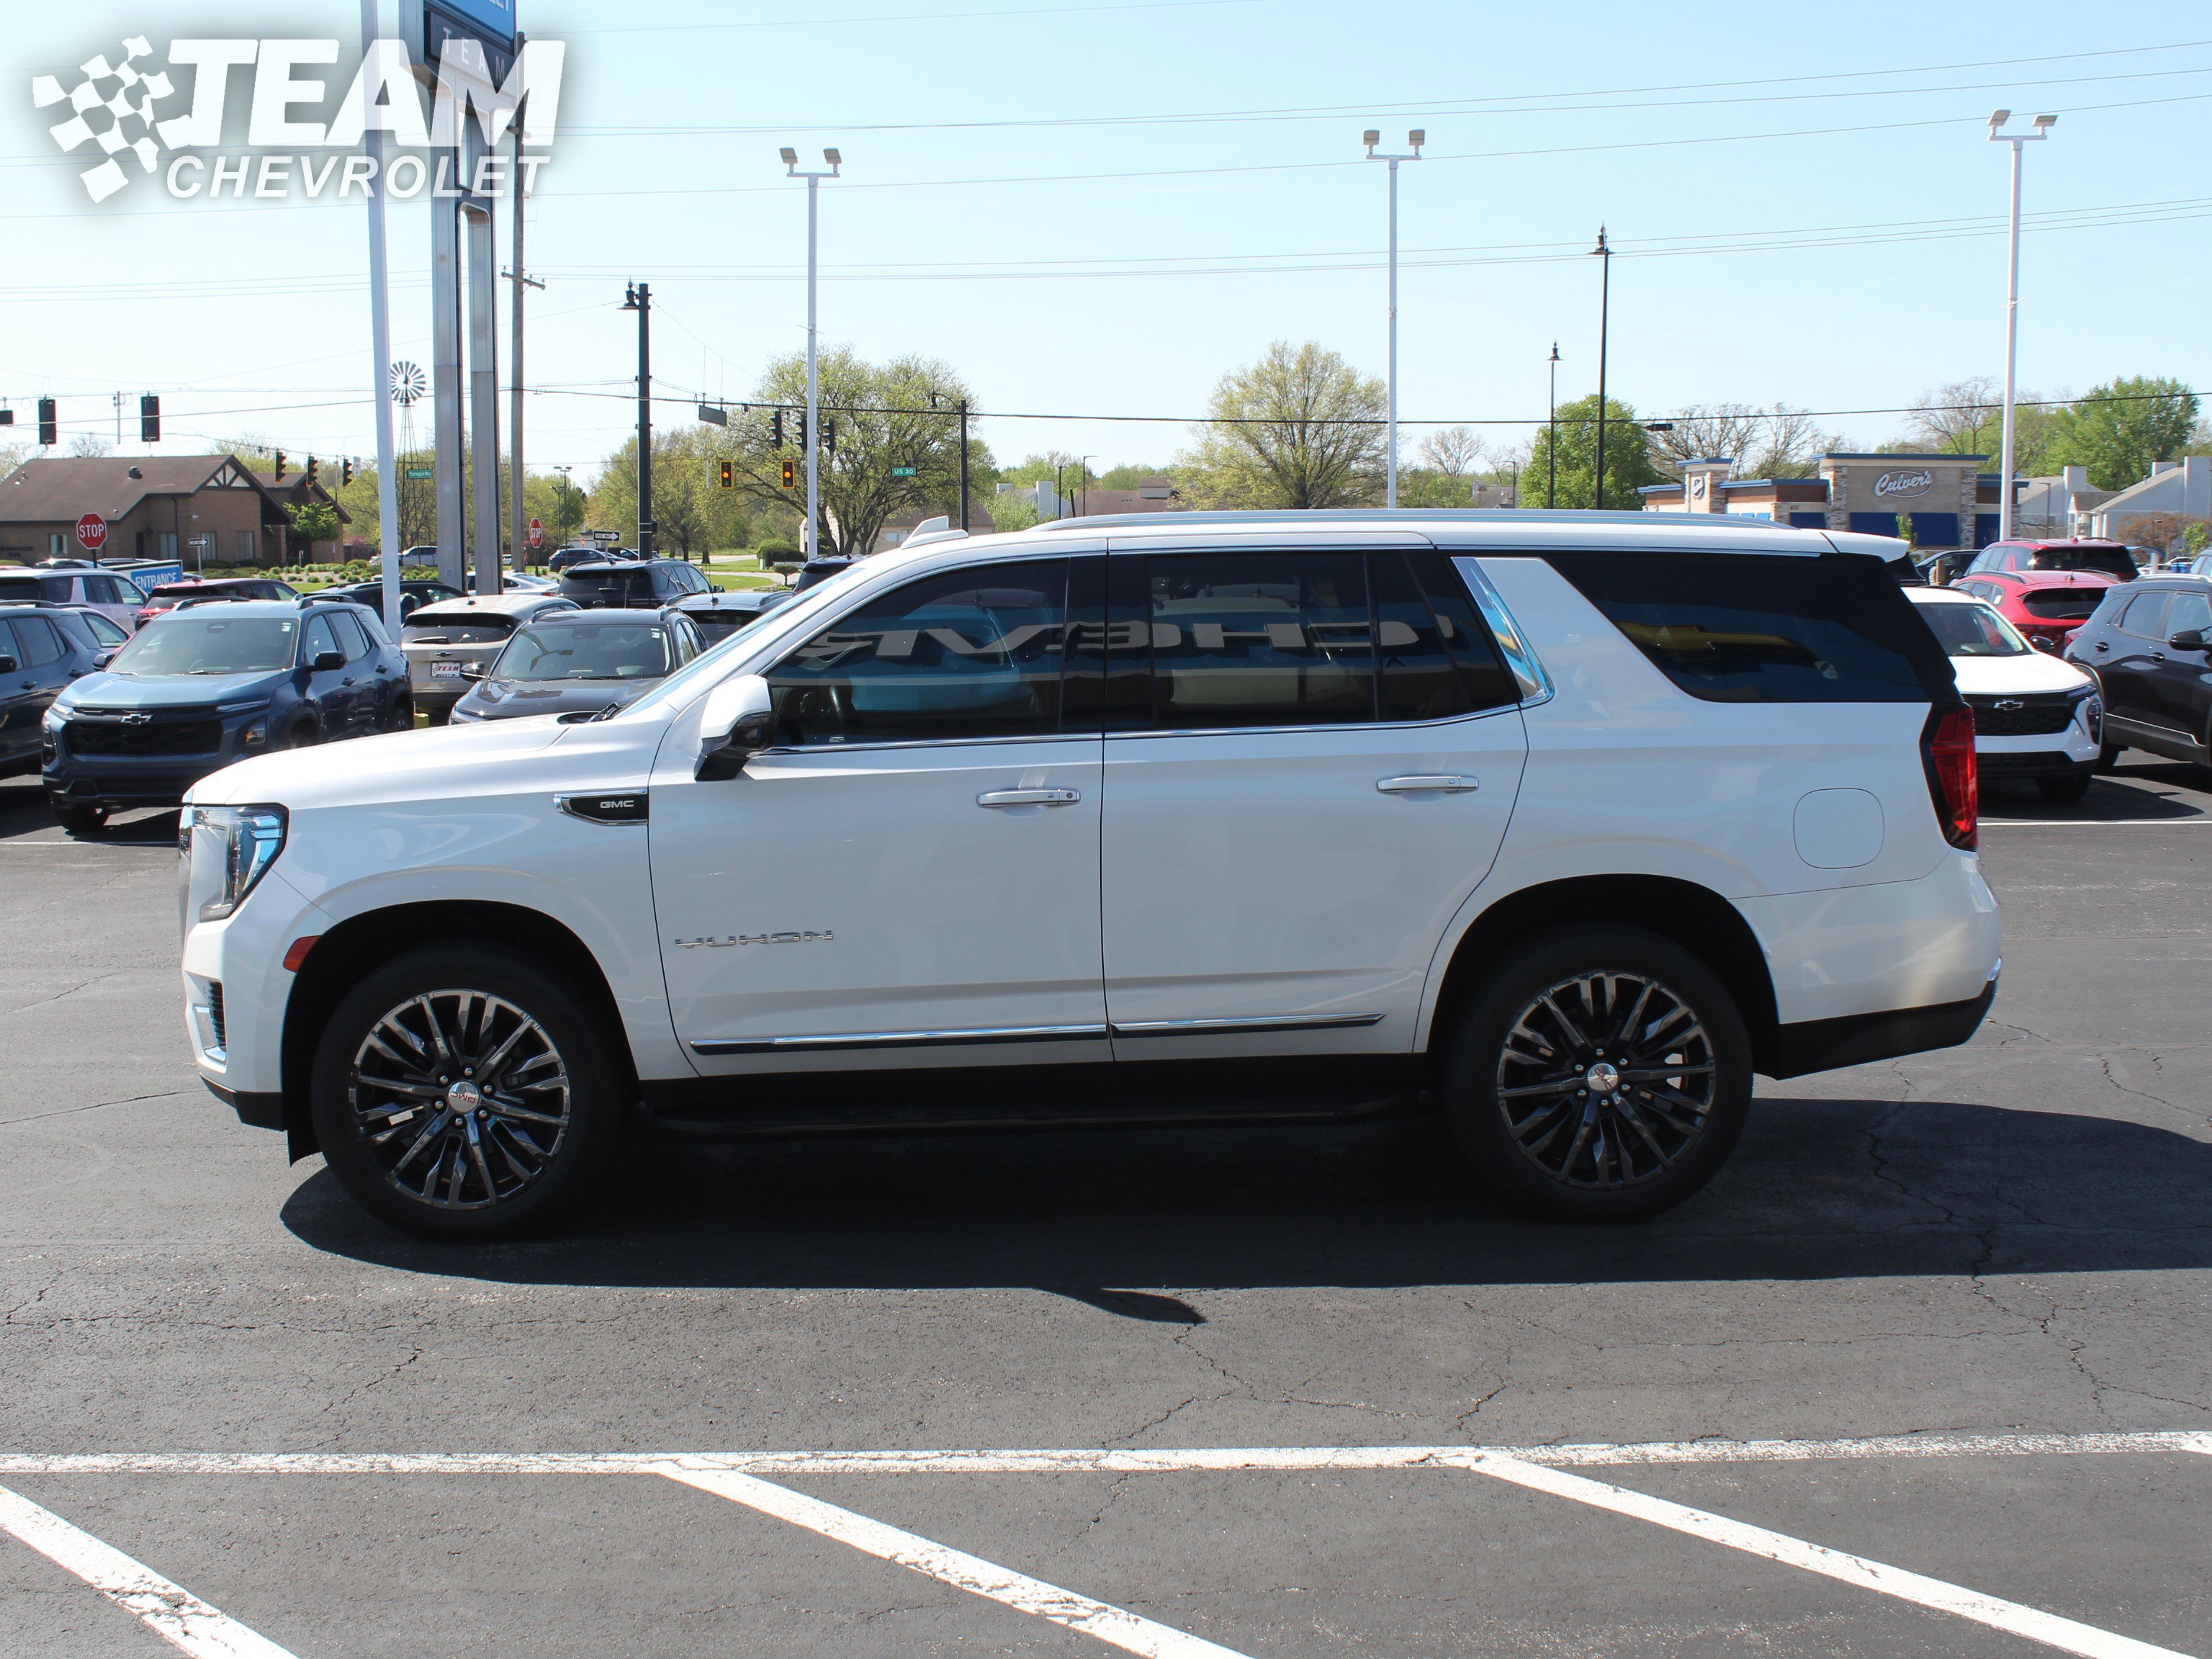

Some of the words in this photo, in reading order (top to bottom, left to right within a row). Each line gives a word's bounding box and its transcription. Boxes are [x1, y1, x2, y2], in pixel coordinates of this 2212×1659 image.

[443, 27, 504, 82] TEAM
[1874, 470, 1933, 496] Culver's
[79, 524, 104, 538] STOP
[530, 527, 541, 539] STOP
[135, 572, 177, 589] ENTRANCE
[601, 800, 634, 809] GMC
[1594, 1067, 1612, 1090] GMC
[451, 1091, 476, 1103] GMC
